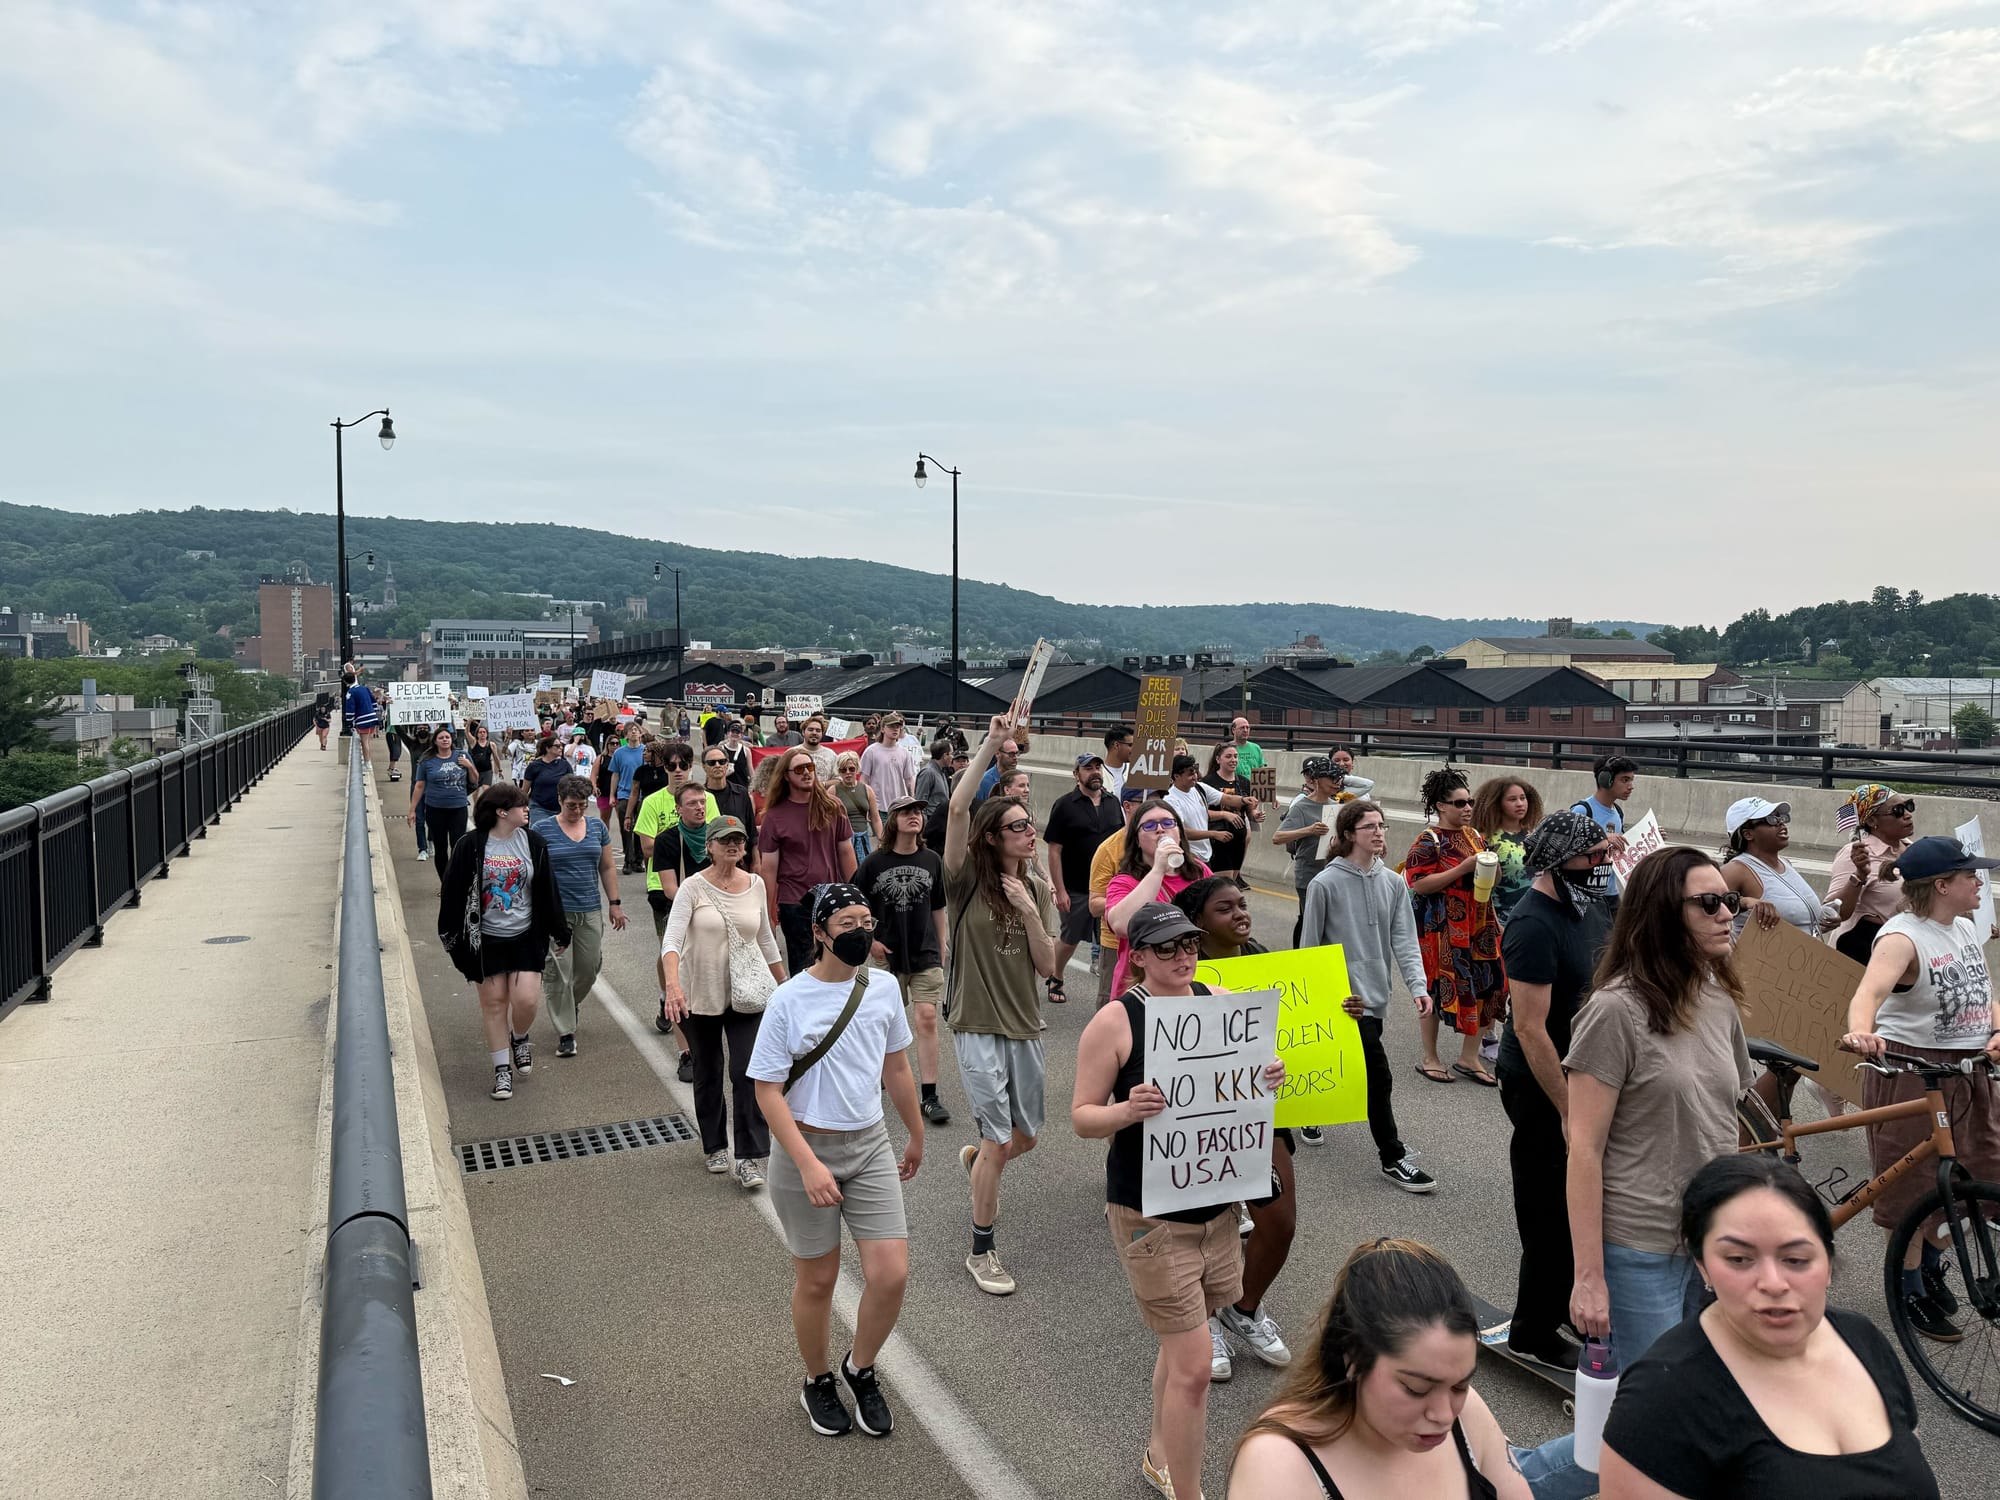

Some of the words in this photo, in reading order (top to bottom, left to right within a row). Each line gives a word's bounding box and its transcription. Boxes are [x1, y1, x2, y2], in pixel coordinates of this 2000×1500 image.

[610, 673, 622, 681] ICE
[1148, 677, 1171, 692] FREE
[396, 683, 442, 696] PEOPLE
[489, 699, 508, 710] FUCK
[511, 697, 528, 709] ICE
[1140, 692, 1178, 707] SPEECH
[399, 711, 411, 723] STOP
[413, 710, 422, 722] THE
[489, 711, 502, 720] NO
[504, 709, 531, 718] HUMAN
[788, 710, 810, 718] STOLEN
[1146, 709, 1167, 723] DUE
[493, 721, 504, 730] IS
[1137, 724, 1176, 738] PROCESS
[1146, 739, 1167, 752] FOR
[1130, 753, 1170, 776] ALL
[1251, 770, 1276, 786] ICE
[1251, 788, 1276, 802] OUT
[1587, 876, 1598, 887] LA
[1752, 929, 1783, 957] NO
[1787, 944, 1840, 990] ONE
[1931, 953, 1954, 968] Wawa
[1153, 1013, 1201, 1052] NO
[1223, 1006, 1262, 1046] ICE
[1277, 1018, 1333, 1051] OLEN
[1278, 1050, 1345, 1101] BORS!
[1152, 1074, 1195, 1109] NO
[1215, 1064, 1265, 1103] KKK
[1149, 1130, 1186, 1161] NO
[1197, 1121, 1267, 1156] FASCIST
[1170, 1155, 1242, 1190] U.S.A.
[1850, 1154, 1914, 1206] MARIN
